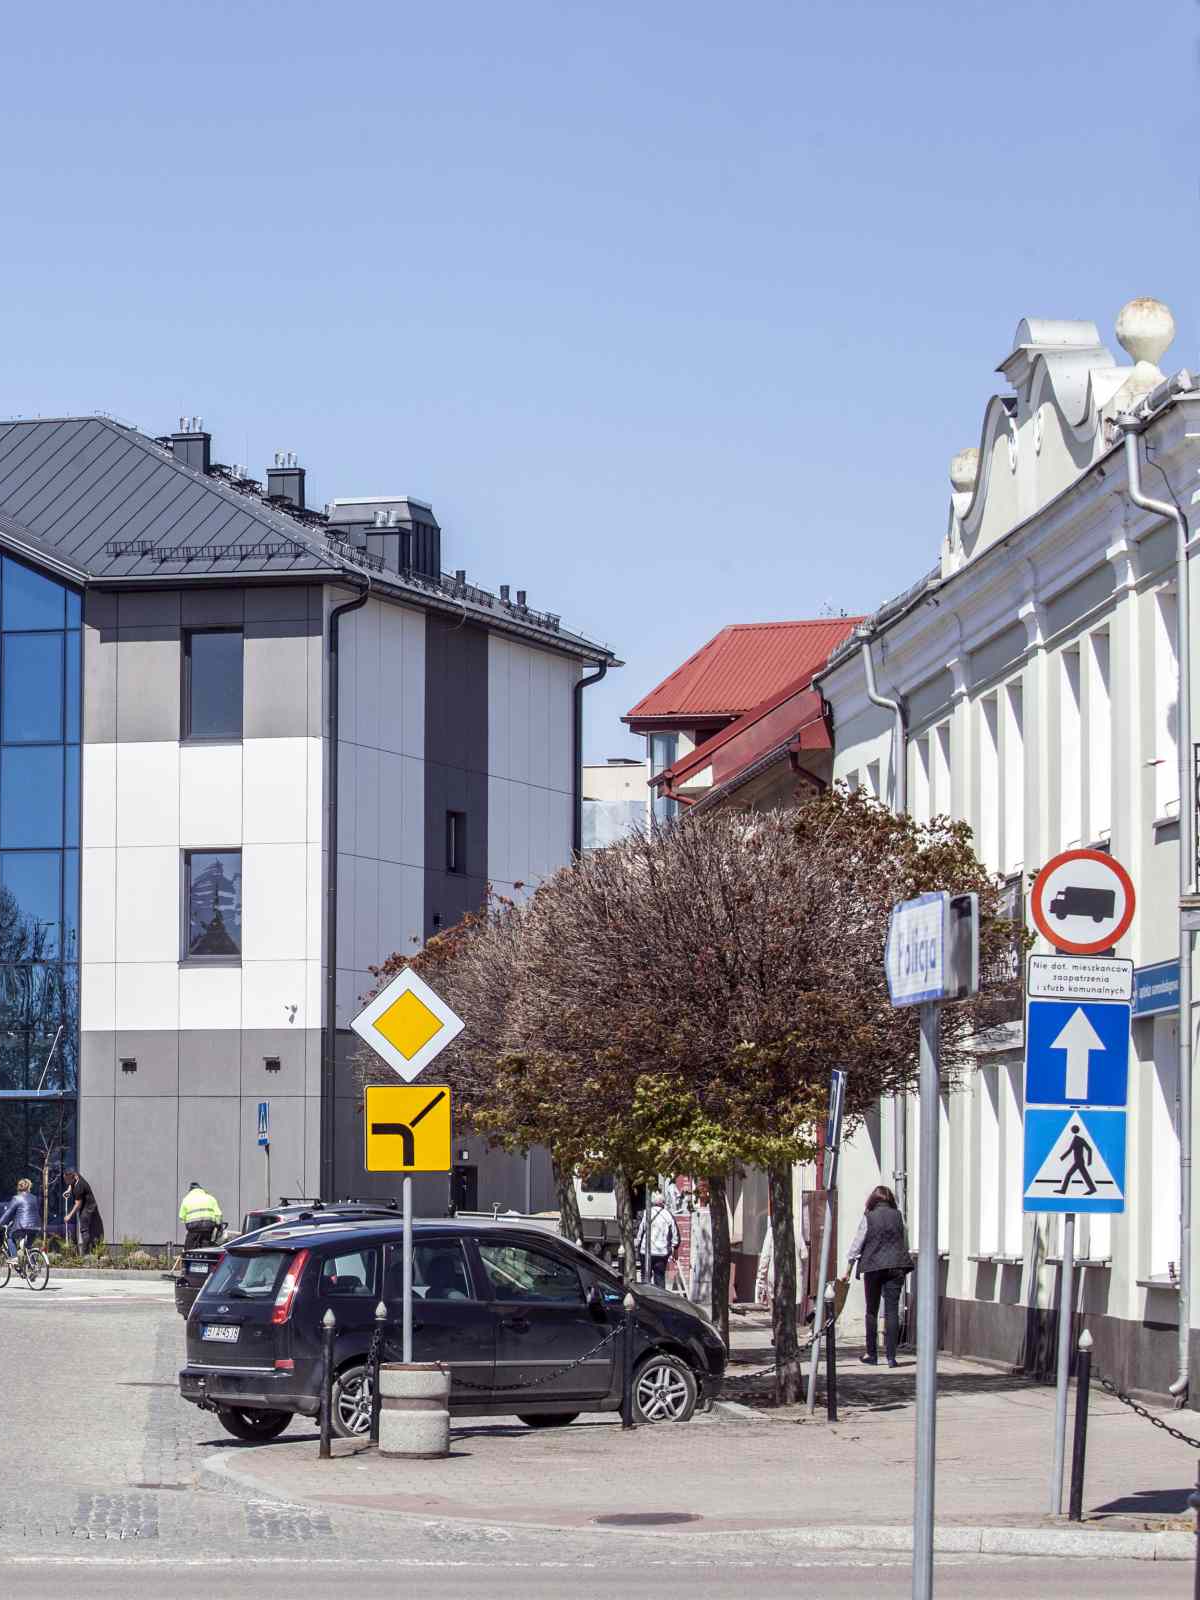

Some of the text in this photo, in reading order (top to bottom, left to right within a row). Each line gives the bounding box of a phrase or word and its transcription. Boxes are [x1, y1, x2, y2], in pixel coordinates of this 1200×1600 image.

[1033, 961, 1047, 969] Nie
[1053, 975, 1110, 984] zaopatrzenia
[1068, 984, 1126, 996] komunalnych
